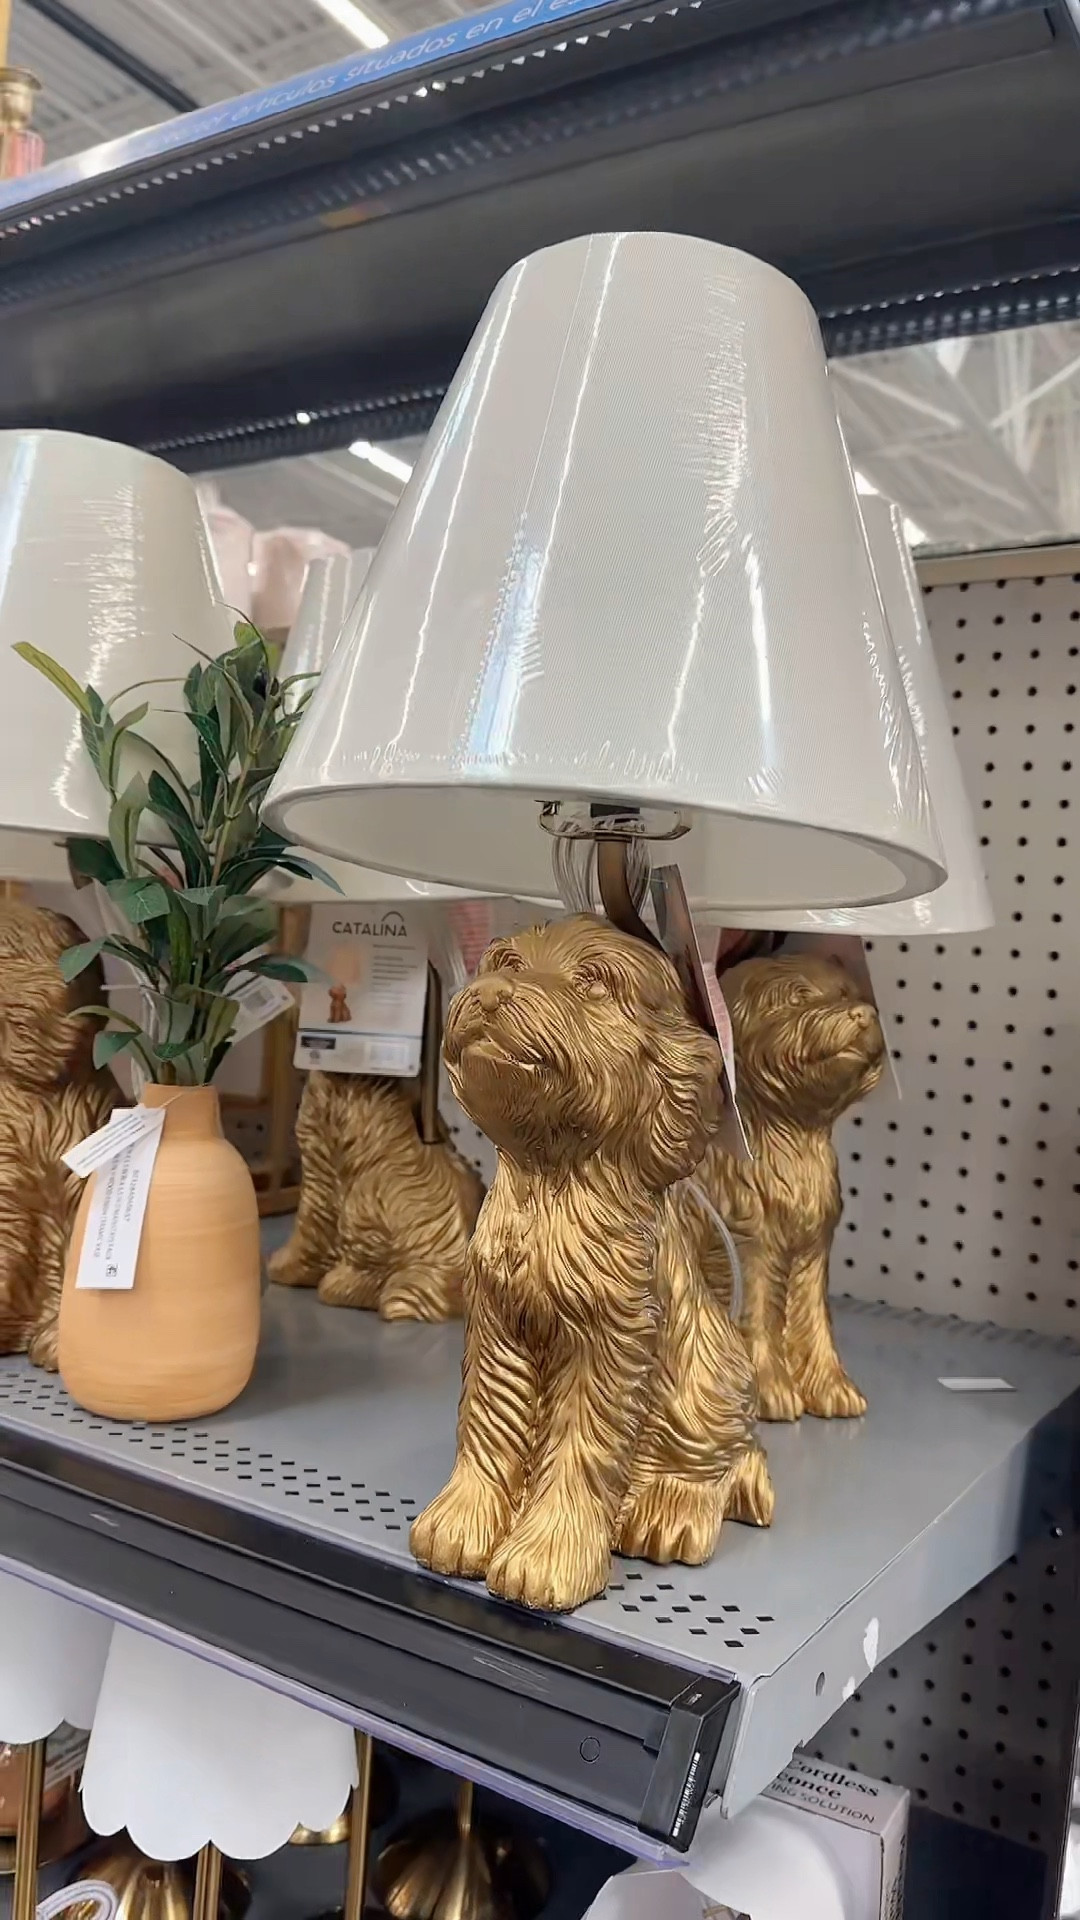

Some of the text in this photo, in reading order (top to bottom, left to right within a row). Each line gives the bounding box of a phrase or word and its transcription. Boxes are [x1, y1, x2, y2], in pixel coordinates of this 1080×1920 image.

[343, 31, 459, 82] situados
[465, 17, 503, 39] en
[512, 0, 543, 23] el
[332, 920, 408, 938] CATALINA
[777, 1771, 841, 1800] conce
[787, 1760, 879, 1798] Cordless
[771, 1783, 875, 1824] ING SOLUTION
